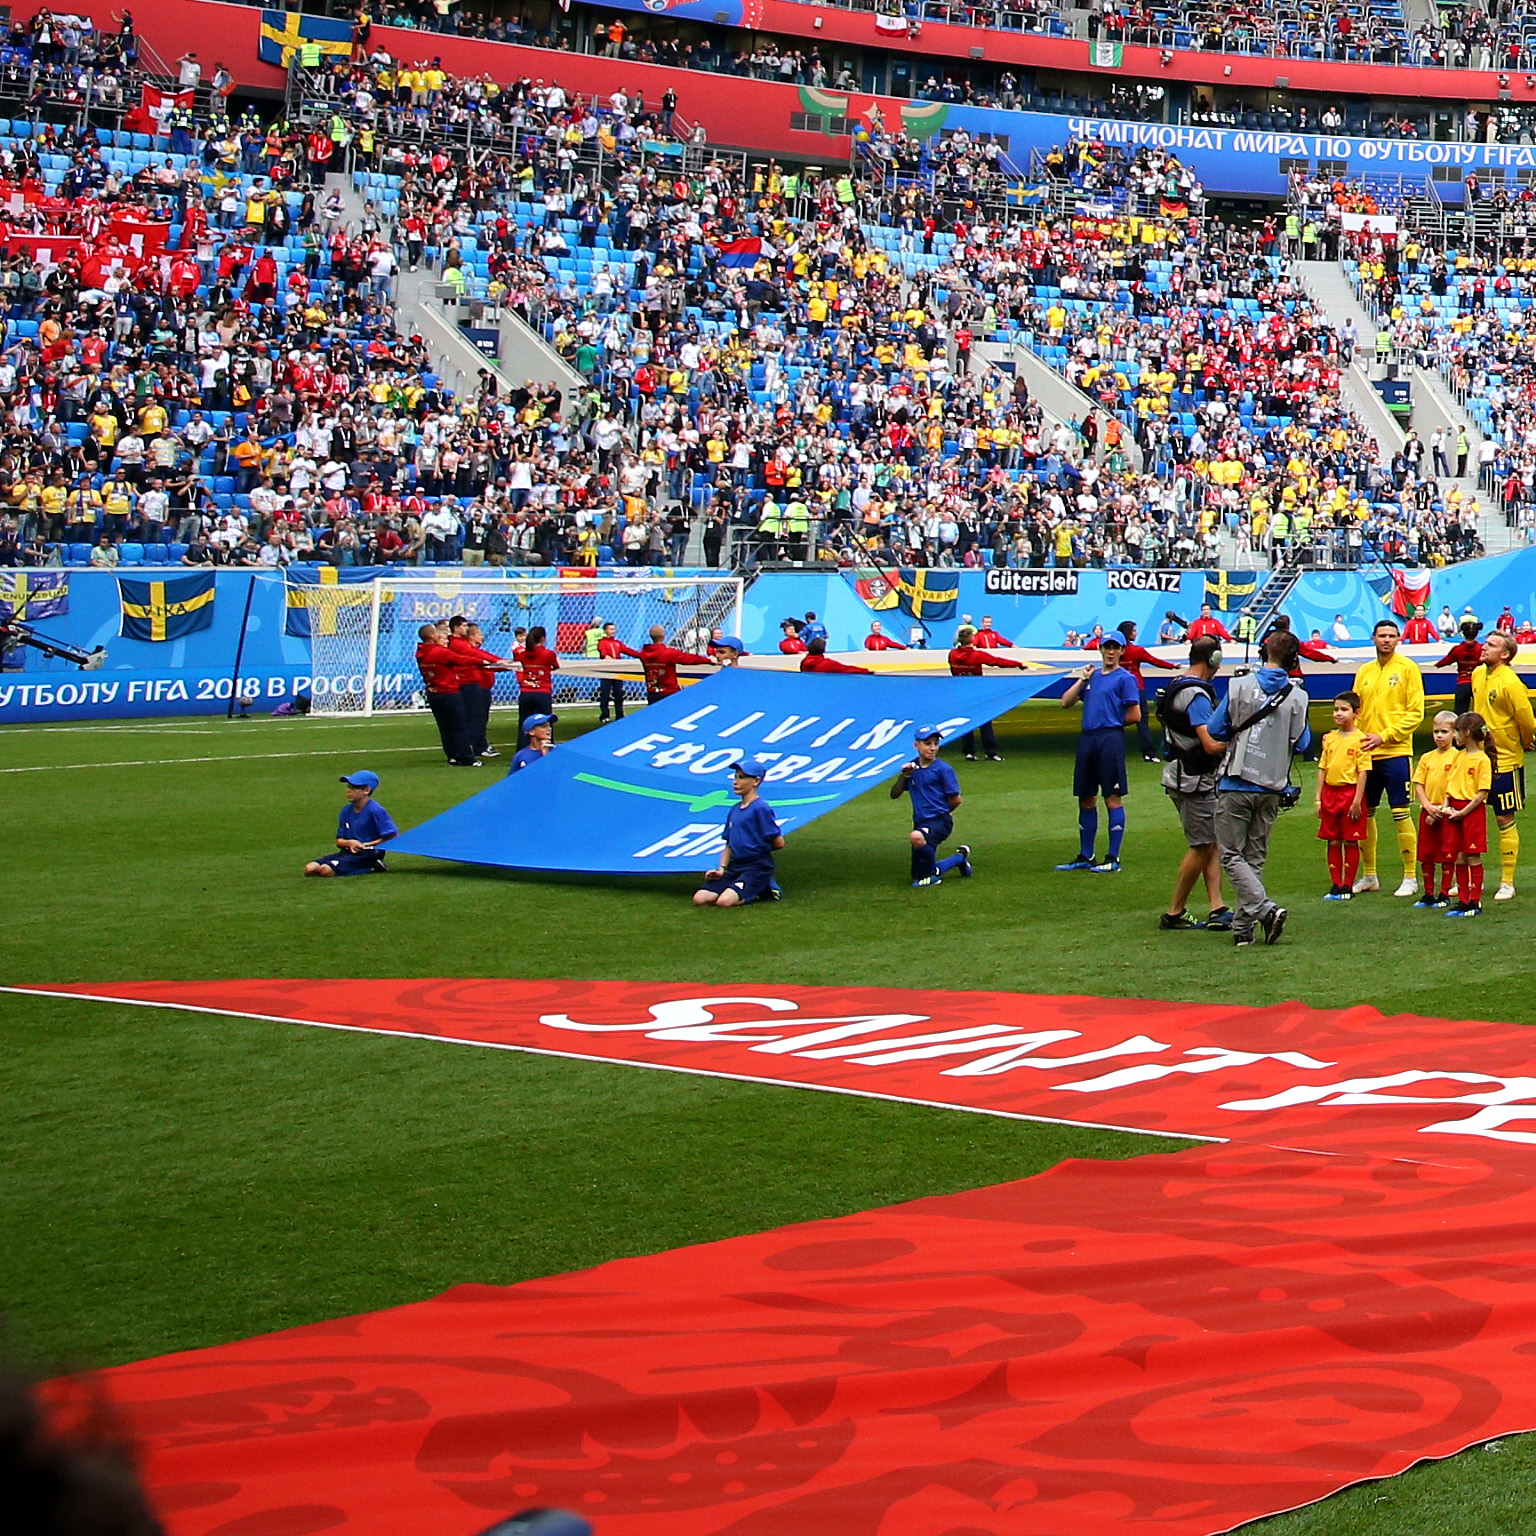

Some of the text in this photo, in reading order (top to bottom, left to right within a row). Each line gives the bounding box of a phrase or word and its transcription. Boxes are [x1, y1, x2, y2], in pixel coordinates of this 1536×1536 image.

[1067, 119, 1227, 151] ЧЕМПИОНАТ
[1233, 133, 1309, 156] МИРА
[1315, 138, 1352, 159] ПО
[1358, 140, 1476, 164] ФУТБОЛУ
[1484, 146, 1536, 167] FIFA
[127, 679, 189, 703] FIFA
[195, 677, 260, 700] 2018
[267, 676, 286, 697] В
[1497, 791, 1515, 811] 10
[540, 997, 1338, 1092] SAINT
